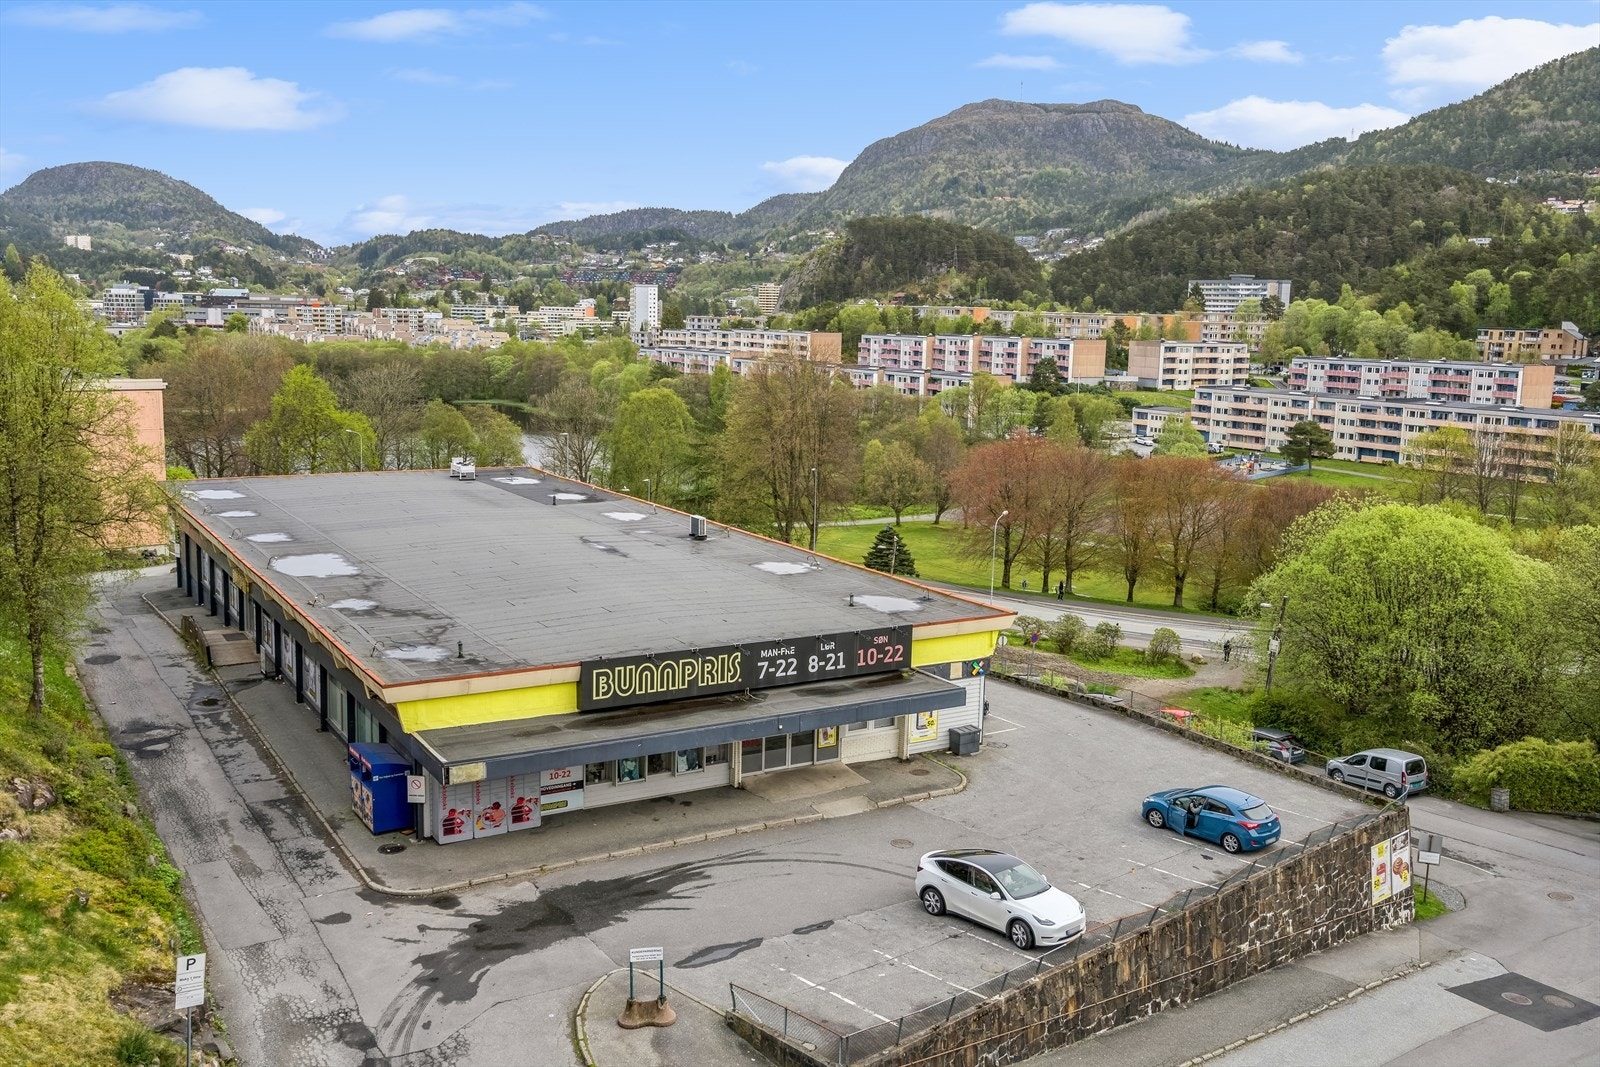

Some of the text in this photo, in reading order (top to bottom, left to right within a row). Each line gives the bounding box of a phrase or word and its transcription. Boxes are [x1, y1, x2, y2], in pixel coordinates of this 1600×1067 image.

[873, 635, 889, 645] SØN
[808, 651, 846, 673] 8-21
[857, 644, 904, 667] 10-22
[592, 652, 742, 700] BUNNPRIS
[757, 657, 798, 680] 7-22
[549, 770, 572, 781] 10-22
[186, 957, 197, 971] P
